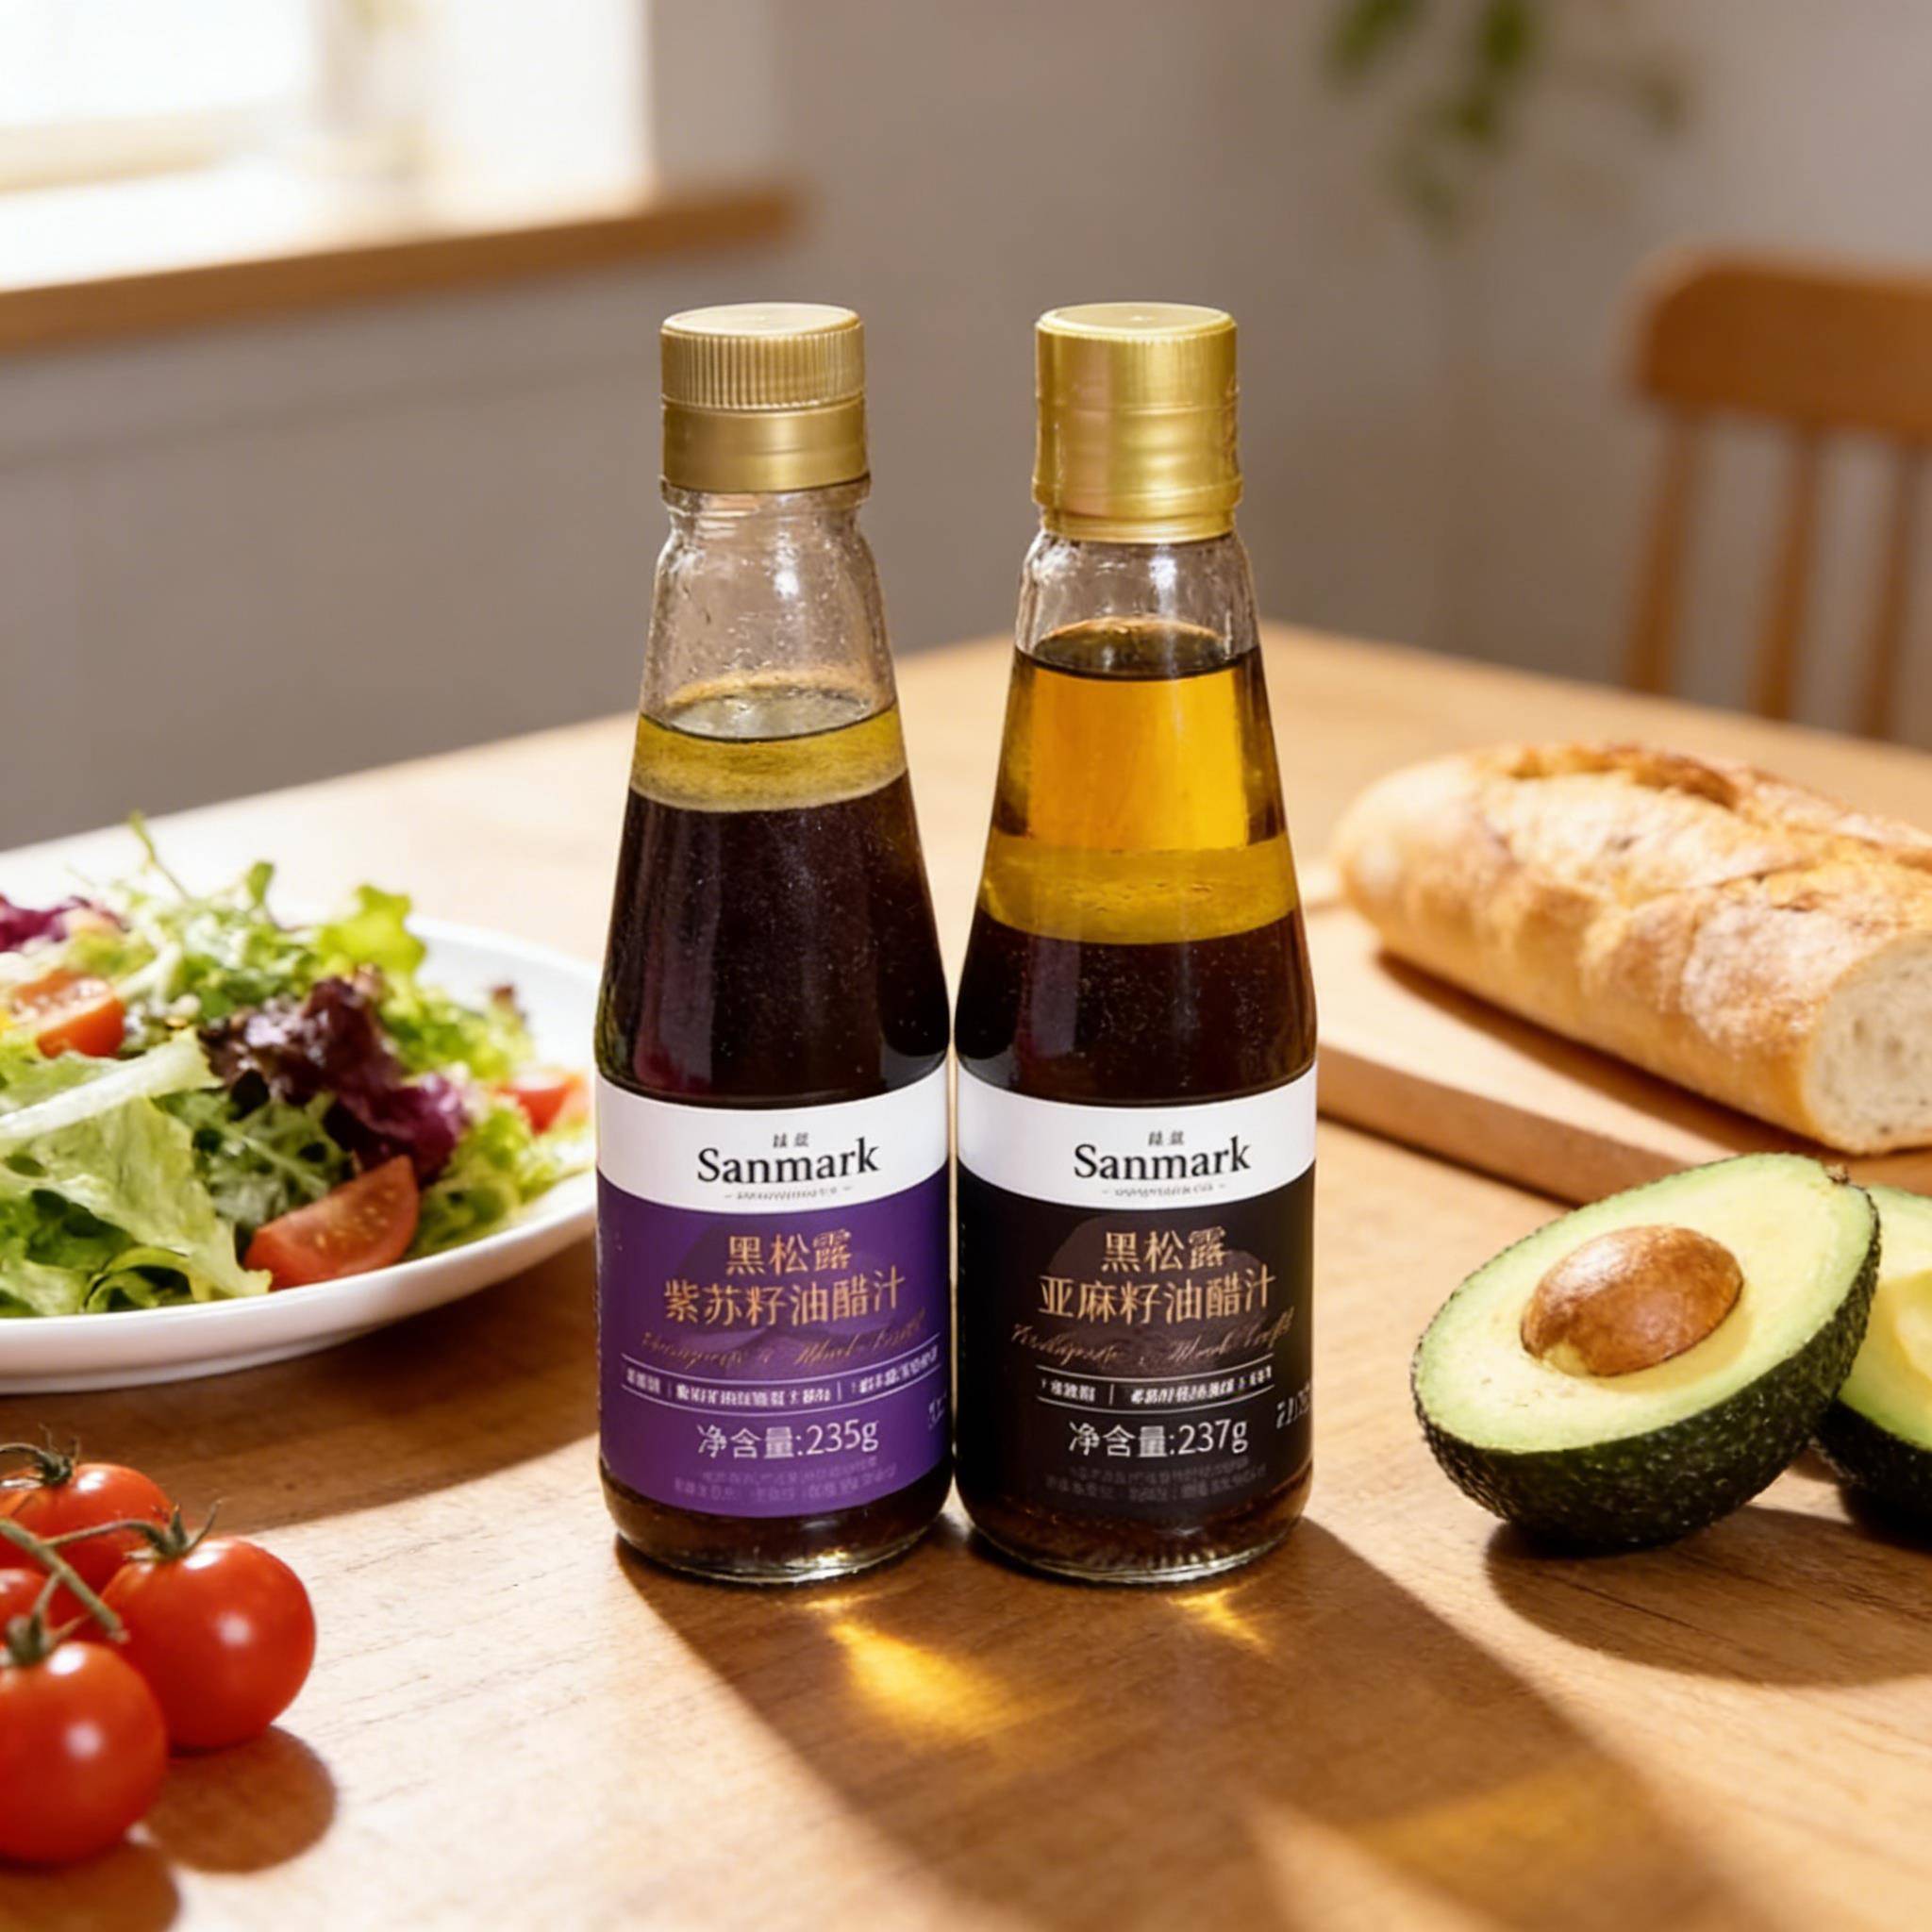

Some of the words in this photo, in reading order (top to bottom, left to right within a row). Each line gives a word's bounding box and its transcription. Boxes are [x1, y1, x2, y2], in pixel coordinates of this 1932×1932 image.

[698, 1137, 880, 1184] Sanmark
[1074, 1135, 1251, 1180] Sanmark
[1101, 1226, 1226, 1274] 黑松露
[664, 1265, 905, 1326] 紫苏籽油醋汁
[1038, 1264, 1276, 1325] 亚麻籽油醋汁
